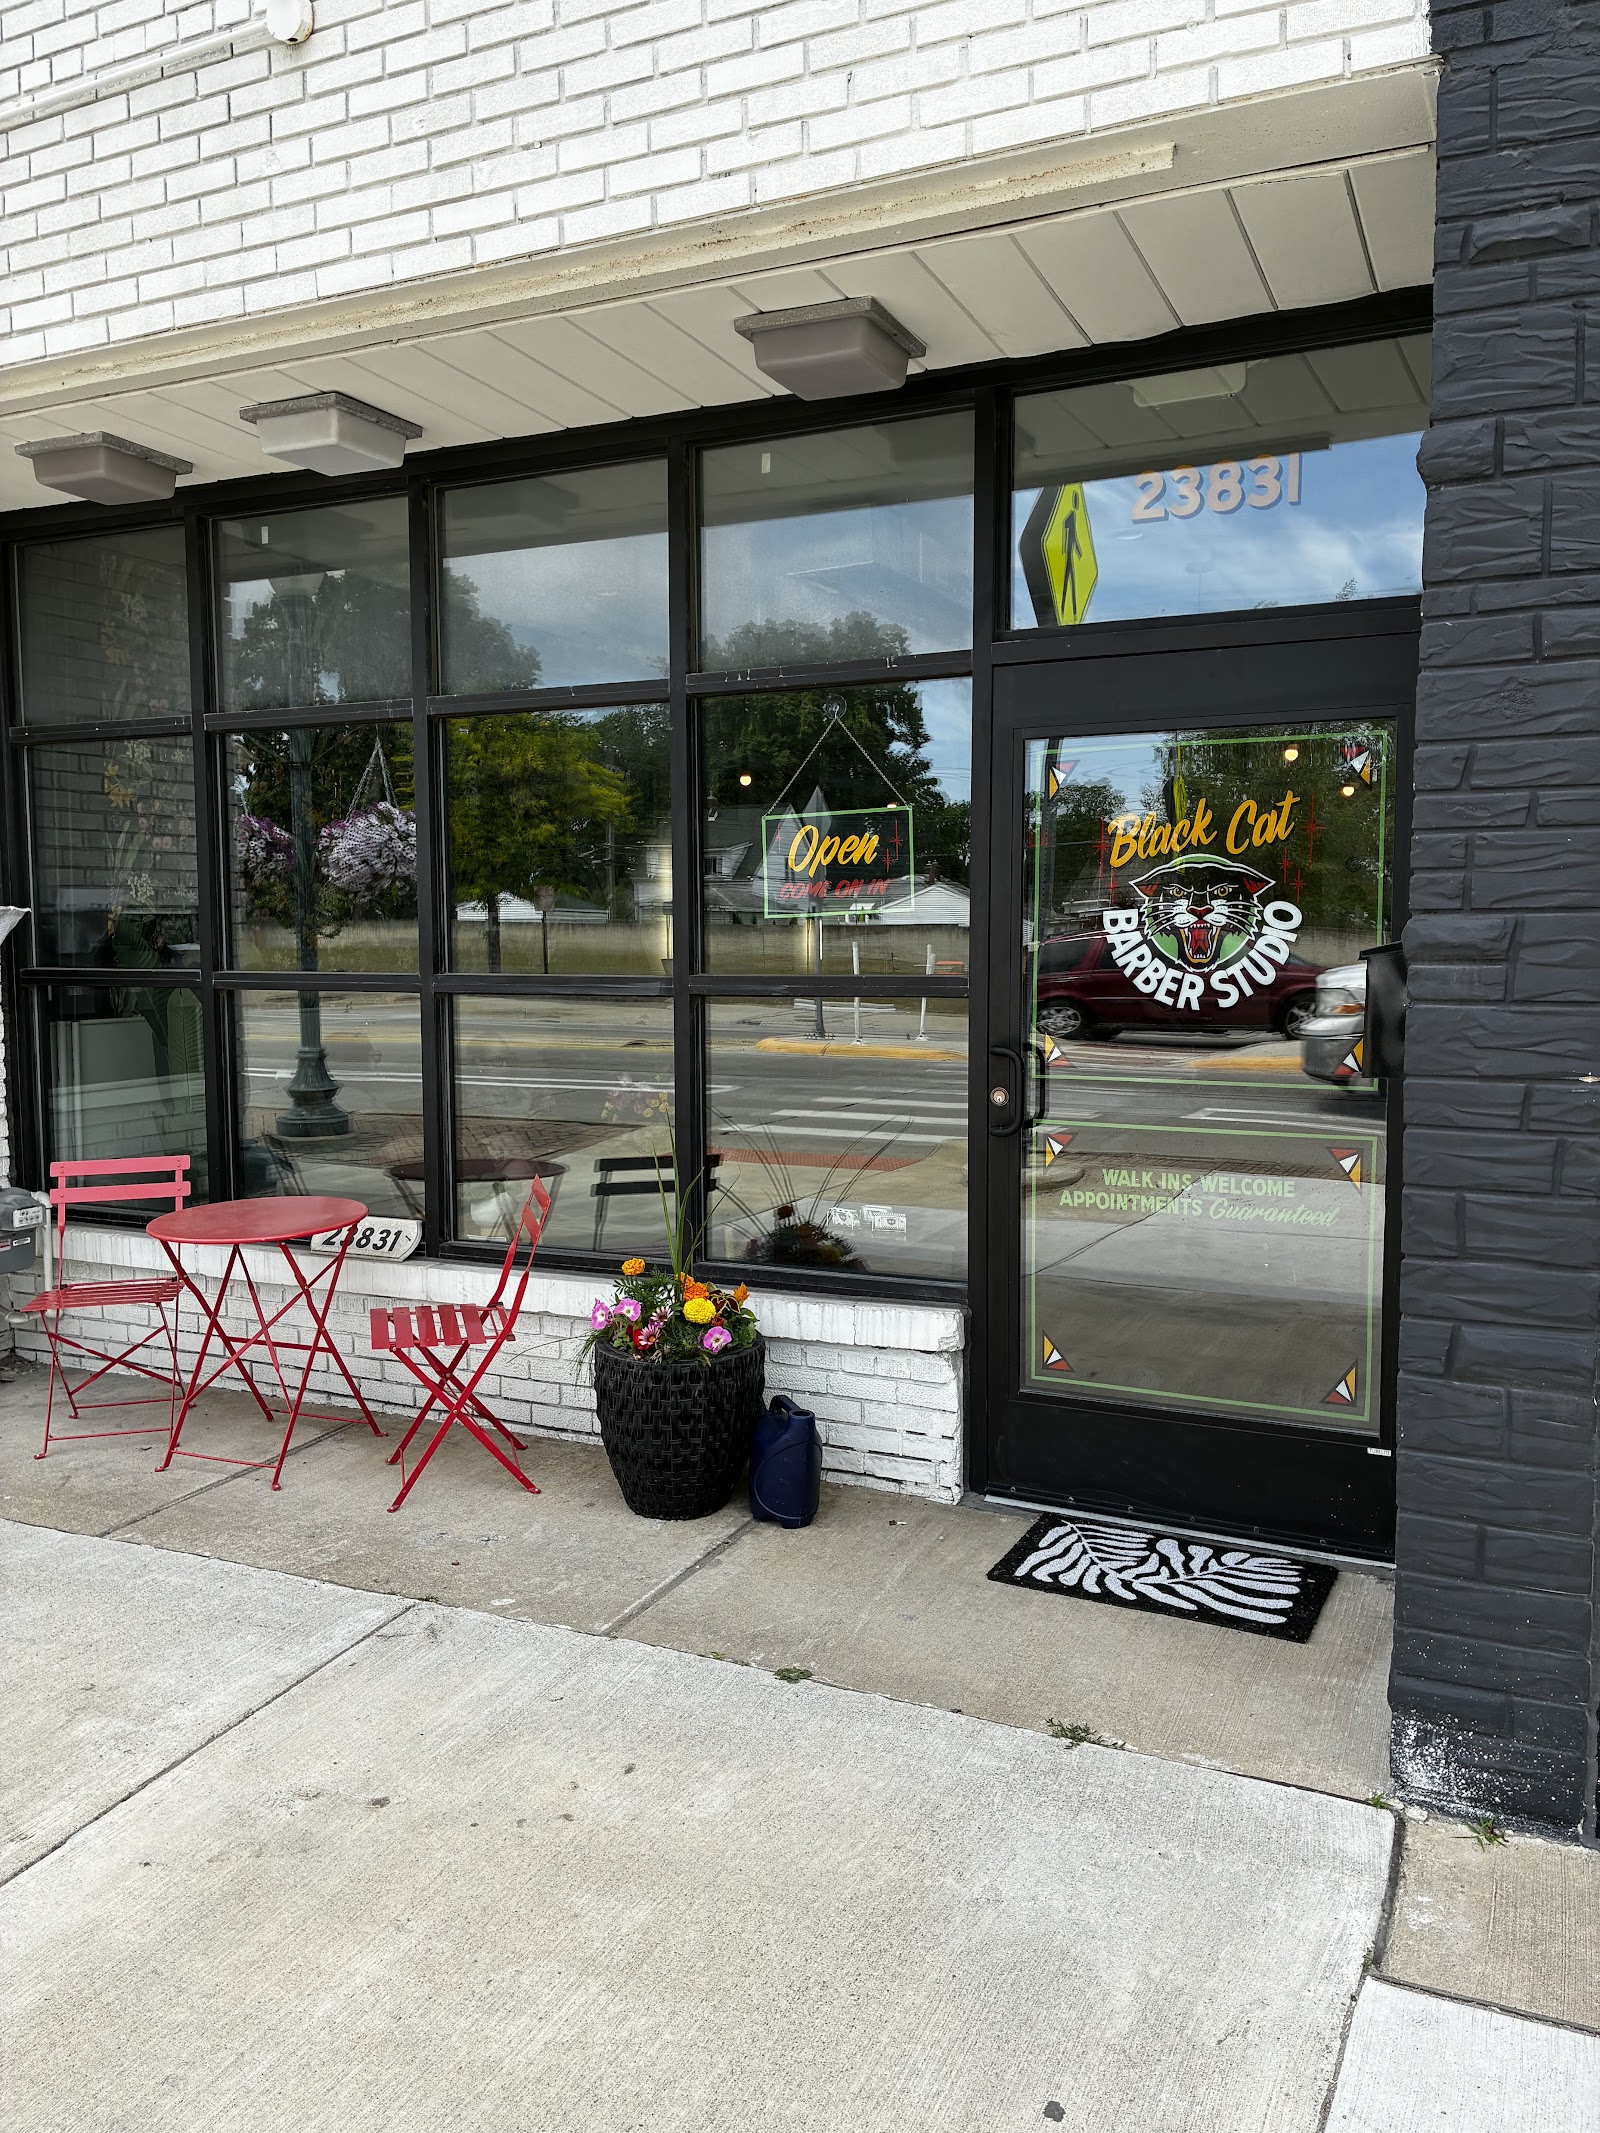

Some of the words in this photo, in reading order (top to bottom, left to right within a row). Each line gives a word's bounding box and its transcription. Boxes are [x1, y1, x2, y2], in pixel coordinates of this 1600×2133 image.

[1131, 451, 1302, 524] 23831
[788, 825, 880, 878] Open
[1107, 798, 1217, 868] Black
[1226, 790, 1300, 855] Cat
[780, 880, 831, 899] COME
[834, 879, 863, 898] ON
[868, 879, 890, 896] IN
[1102, 908, 1205, 1011] BARBER
[1210, 900, 1302, 1008] STUDIO
[1059, 1190, 1202, 1217] APPOINTMENTS
[1208, 1198, 1339, 1228] Guaranteed
[1102, 1168, 1154, 1189] WALK
[1161, 1171, 1192, 1191] INS
[1200, 1174, 1295, 1198] WELCOME
